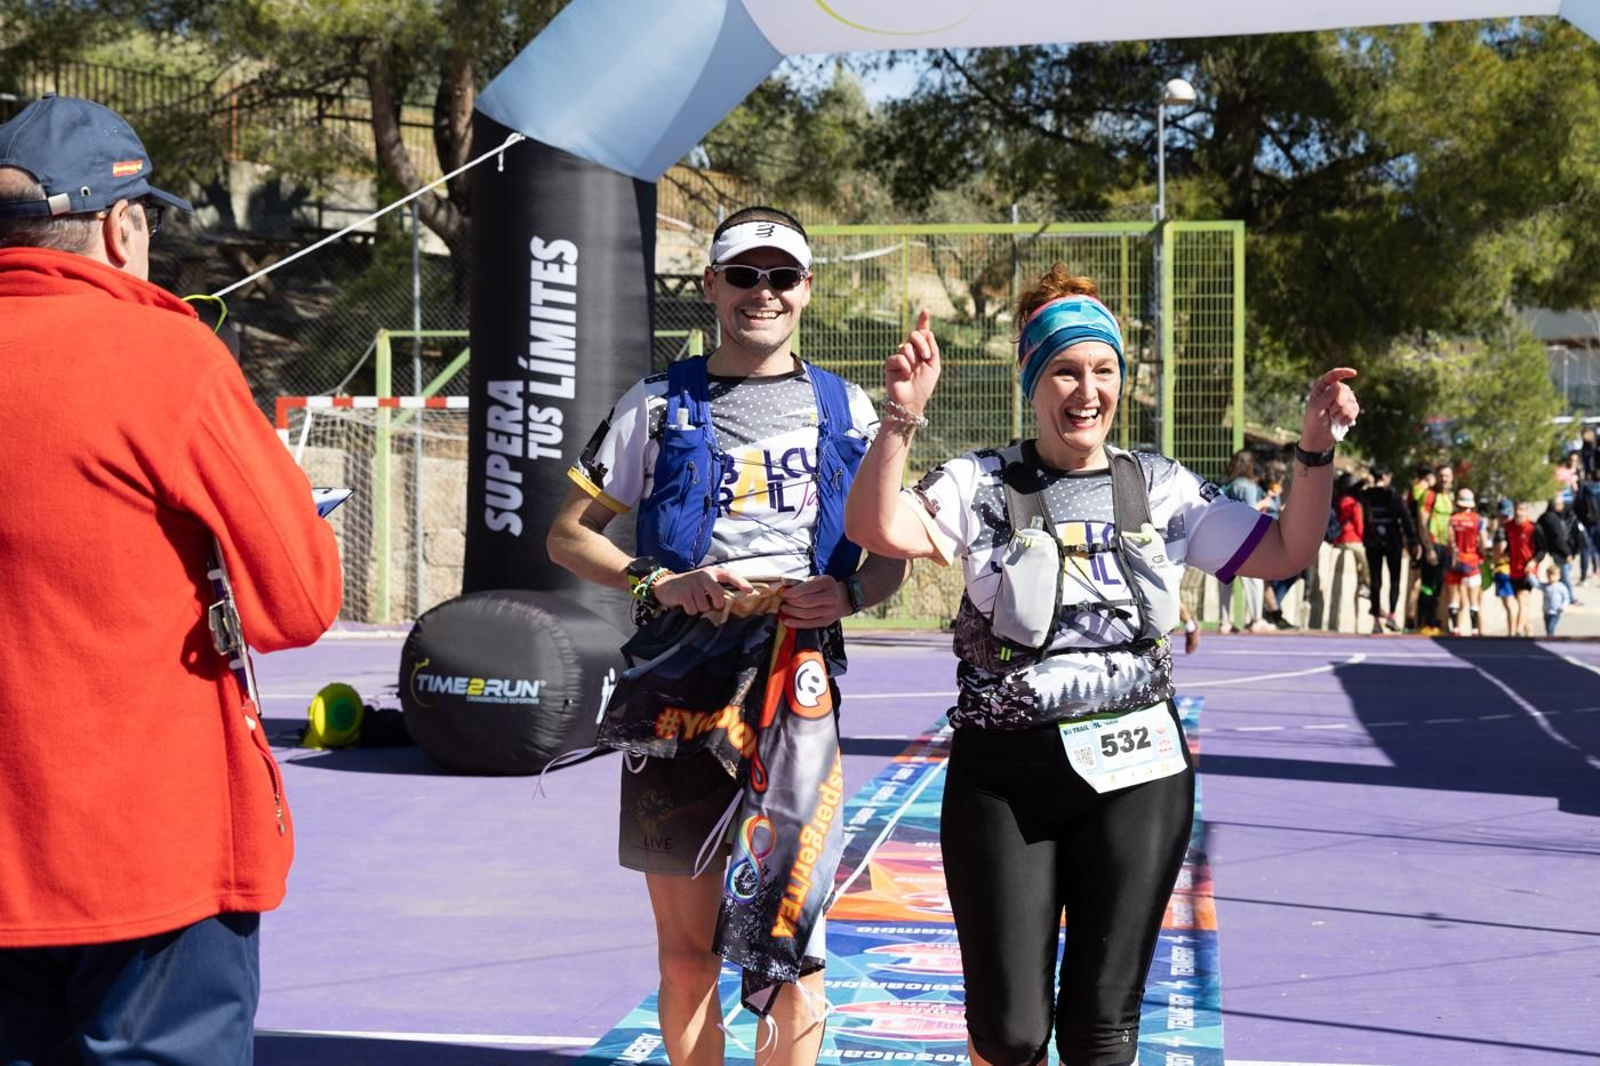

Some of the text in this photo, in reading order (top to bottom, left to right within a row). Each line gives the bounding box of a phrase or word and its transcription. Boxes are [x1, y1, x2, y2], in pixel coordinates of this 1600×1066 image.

[518, 235, 579, 460] TUS LÍMITES
[485, 380, 524, 537] SUPERA
[1100, 726, 1152, 757] 532
[644, 836, 675, 850] LIVE
